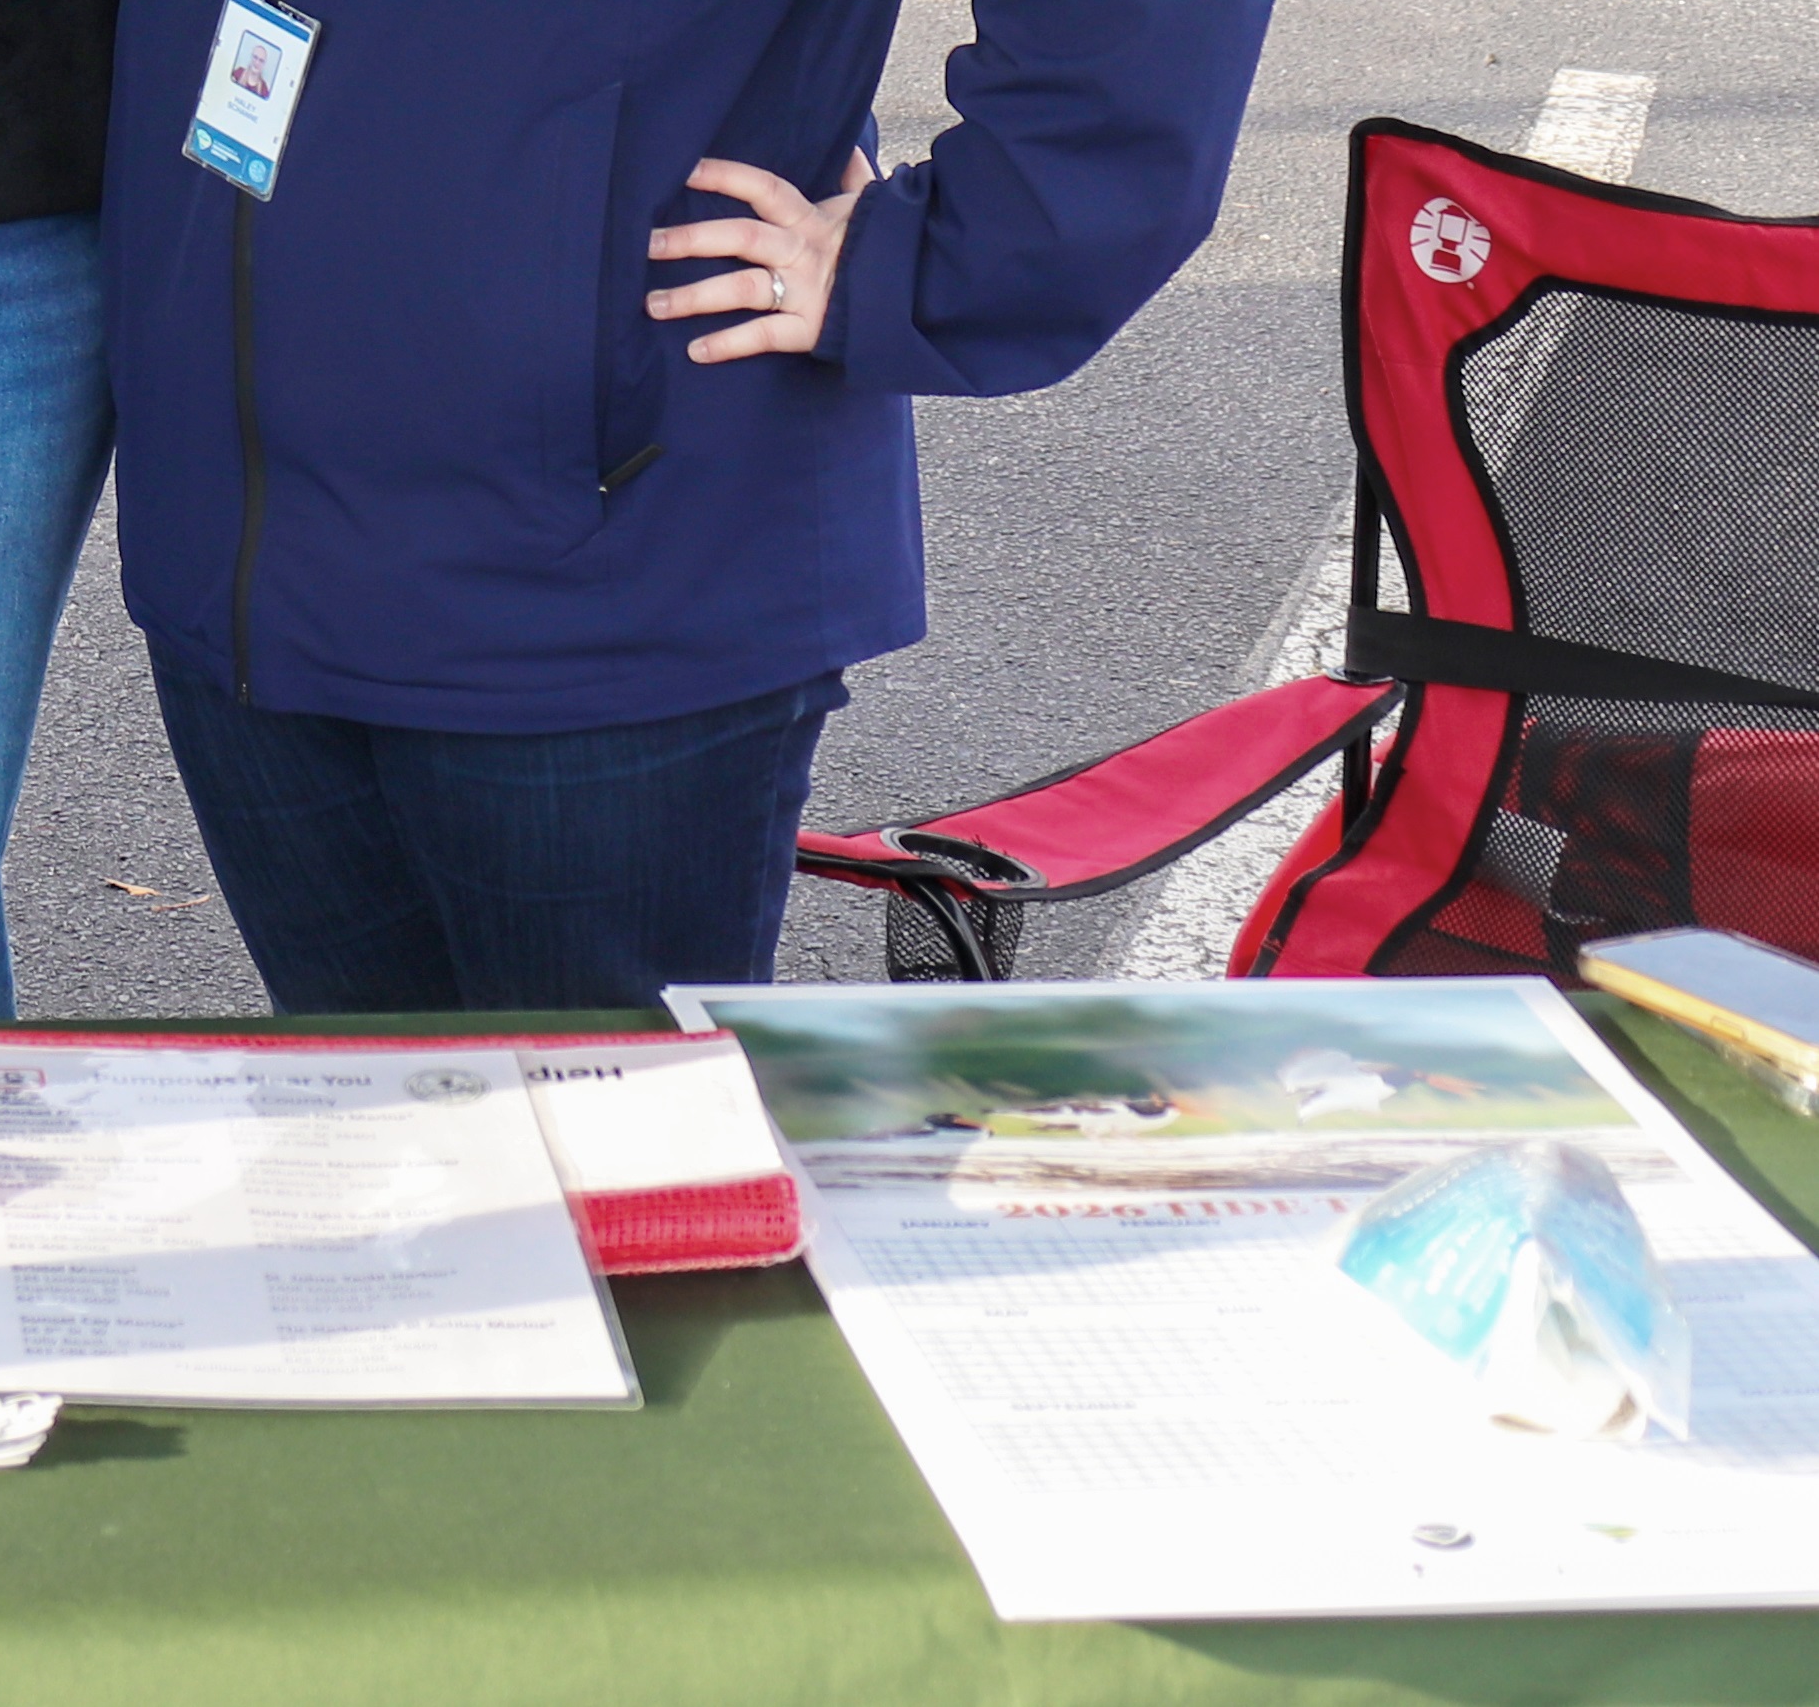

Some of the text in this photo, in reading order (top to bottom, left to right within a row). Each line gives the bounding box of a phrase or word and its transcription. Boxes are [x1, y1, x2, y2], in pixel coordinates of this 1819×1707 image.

[321, 1074, 372, 1087] You
[527, 1065, 624, 1082] Help
[996, 1201, 1148, 1221] 2026
[1154, 1197, 1312, 1220] TIDE
